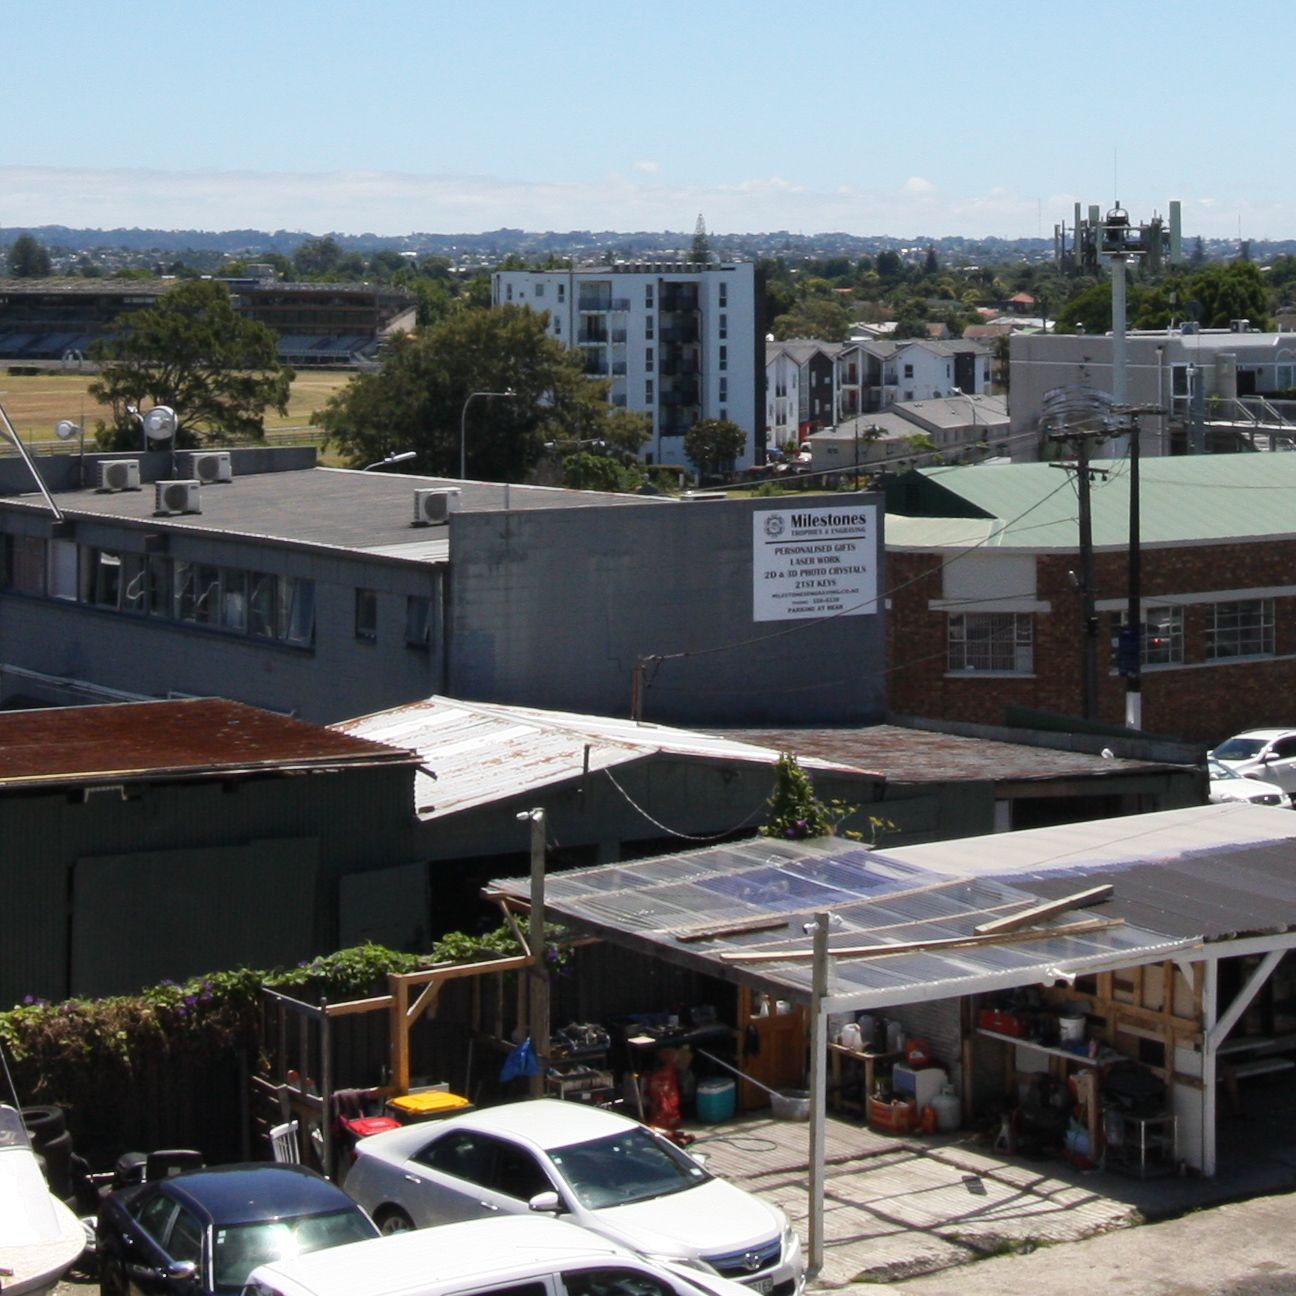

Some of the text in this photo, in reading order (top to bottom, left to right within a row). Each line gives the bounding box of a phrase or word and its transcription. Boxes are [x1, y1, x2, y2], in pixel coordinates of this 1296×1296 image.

[791, 513, 866, 527] Milestones
[775, 543, 856, 555] PERSONALISED GIFTS
[790, 555, 841, 566] LASER WORK
[765, 571, 777, 579] 2D
[787, 569, 798, 578] 3D
[799, 567, 827, 577] PHOTO
[828, 565, 866, 576] CRYSTALS
[795, 580, 836, 589] 21ST KEYS
